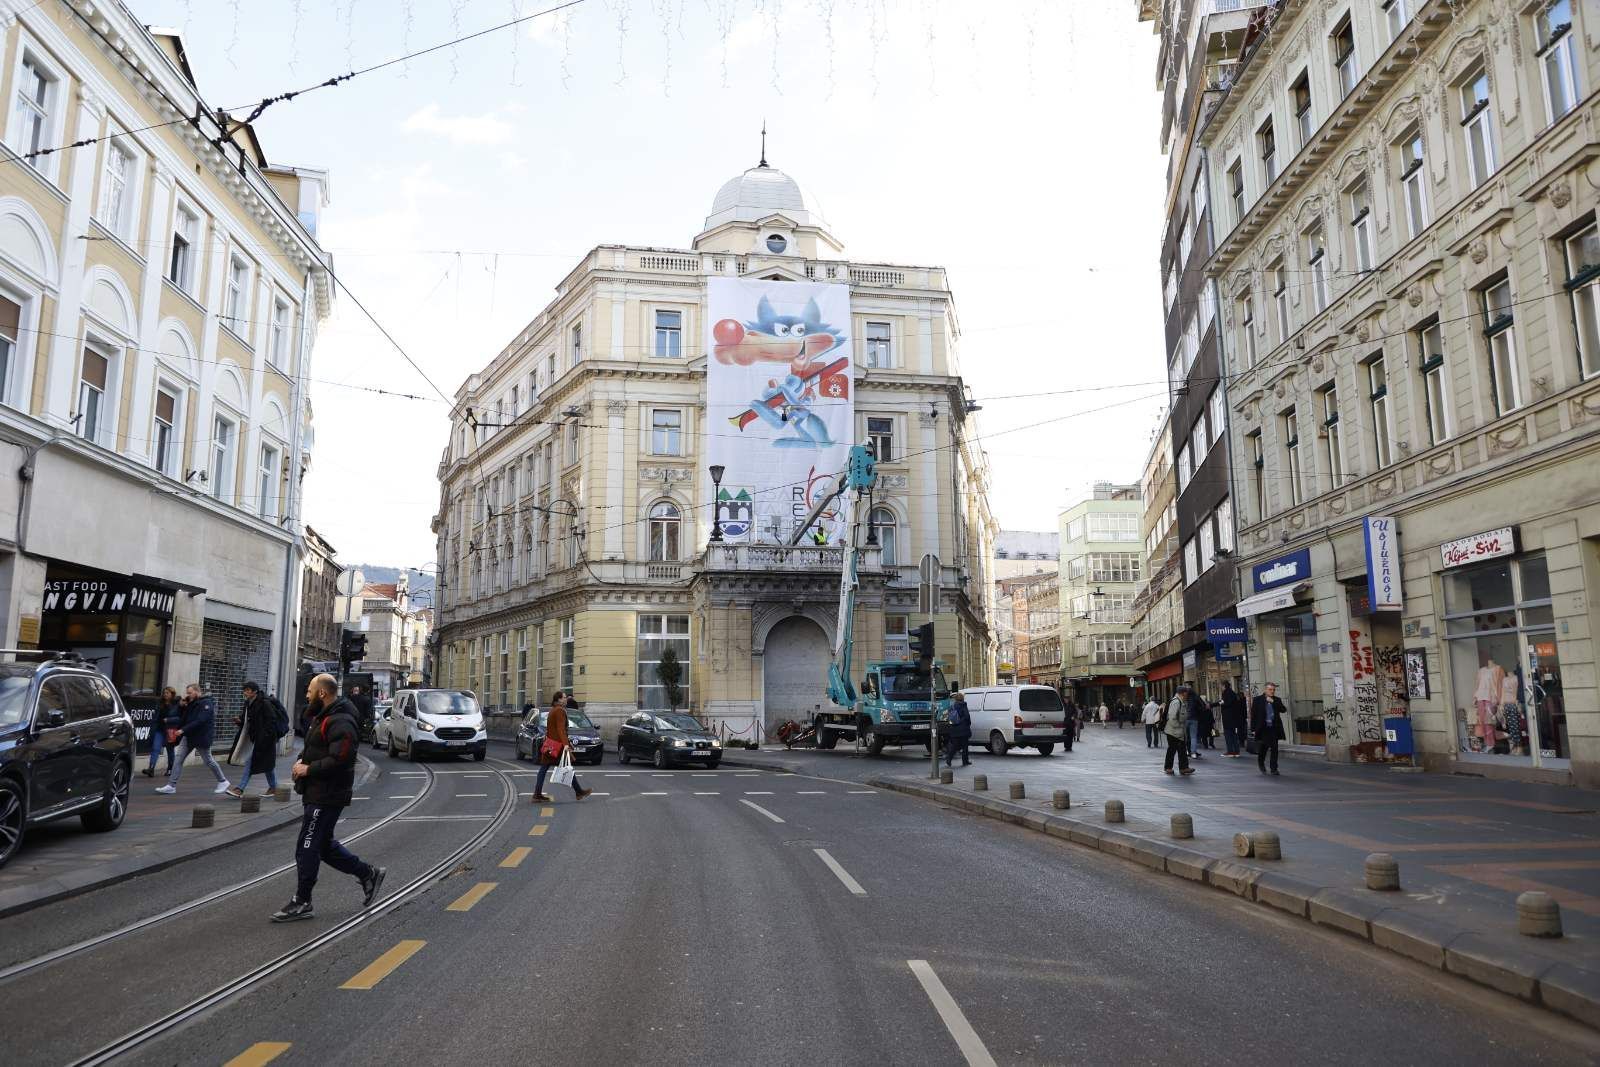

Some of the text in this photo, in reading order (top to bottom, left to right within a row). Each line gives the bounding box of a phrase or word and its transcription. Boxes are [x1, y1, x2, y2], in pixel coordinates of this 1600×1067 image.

[44, 581, 108, 592] AST FOOD
[44, 592, 127, 611] NGVIN
[130, 587, 175, 613] PINGVIN
[130, 709, 143, 721] FAST
[303, 808, 321, 849] GIVOVA
